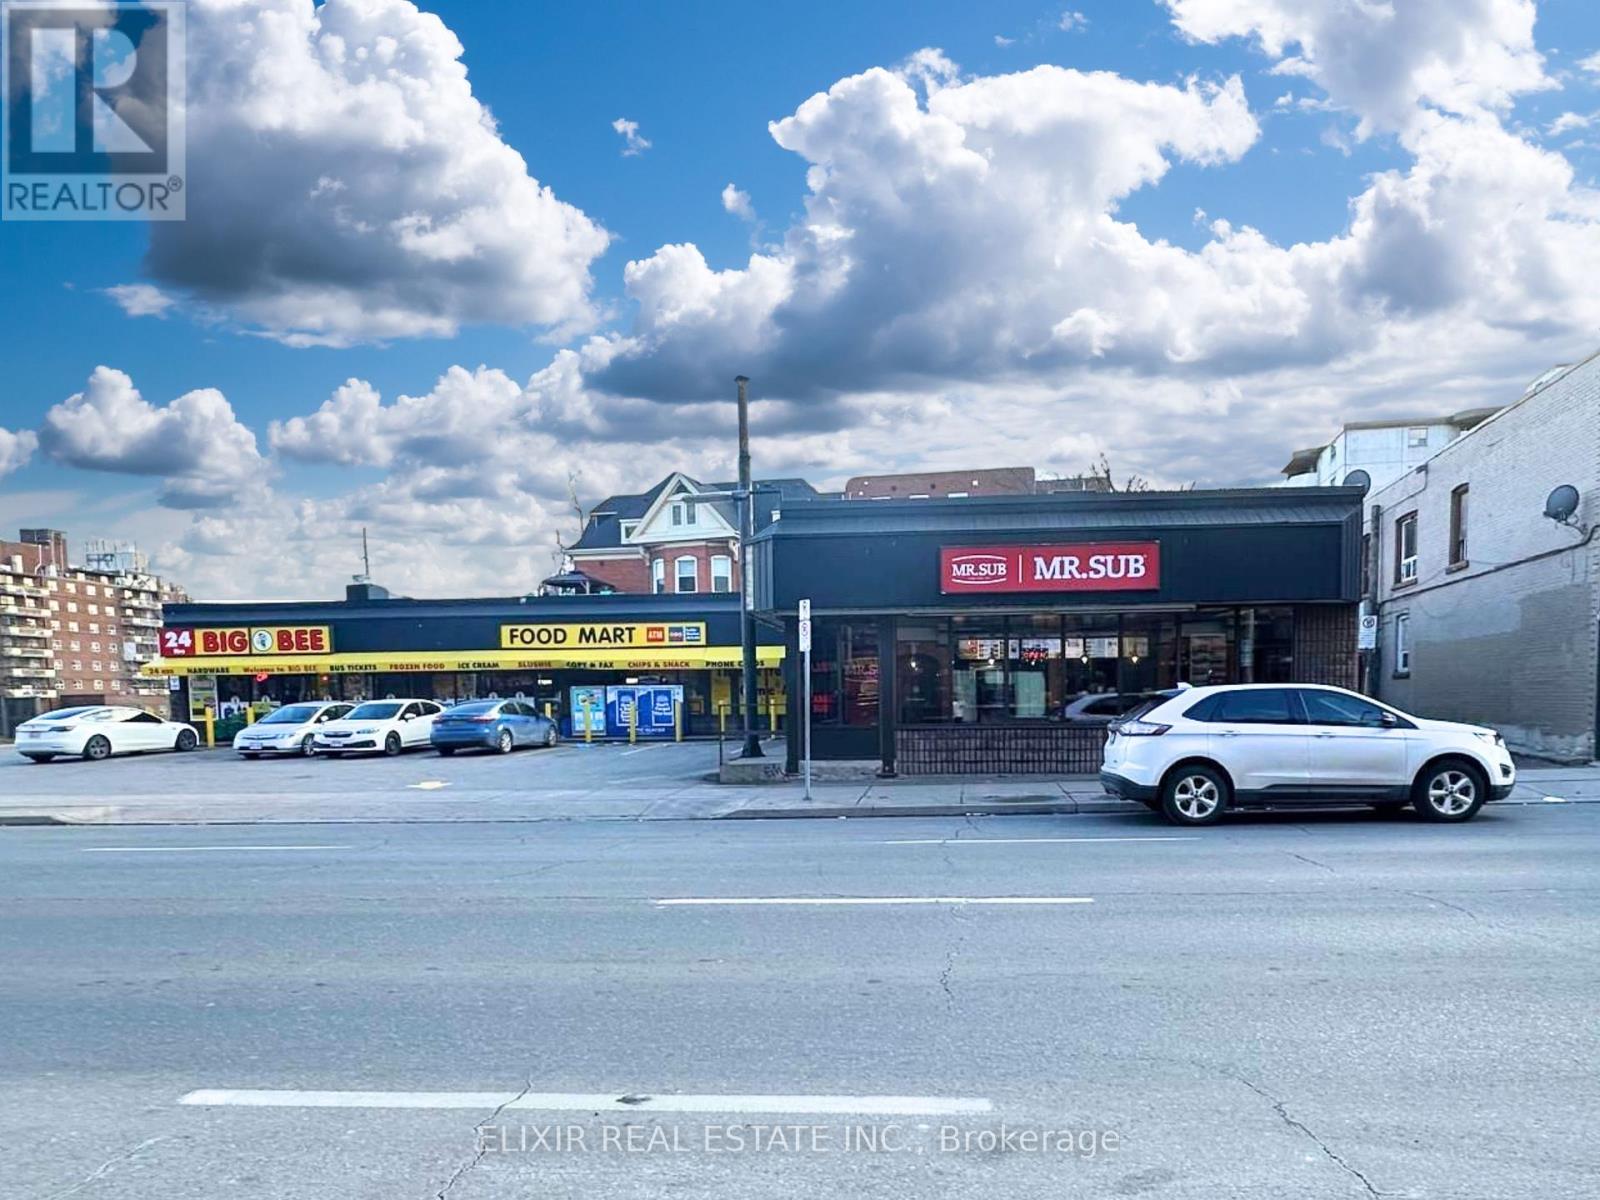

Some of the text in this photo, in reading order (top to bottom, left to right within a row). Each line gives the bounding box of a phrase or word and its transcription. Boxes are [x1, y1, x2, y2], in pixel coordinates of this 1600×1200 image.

[952, 562, 1007, 577] MR.SUB
[1034, 555, 1146, 580] MR.SUB
[165, 631, 192, 647] 24
[203, 629, 324, 653] BIG BEE
[509, 627, 636, 644] FOOD MART
